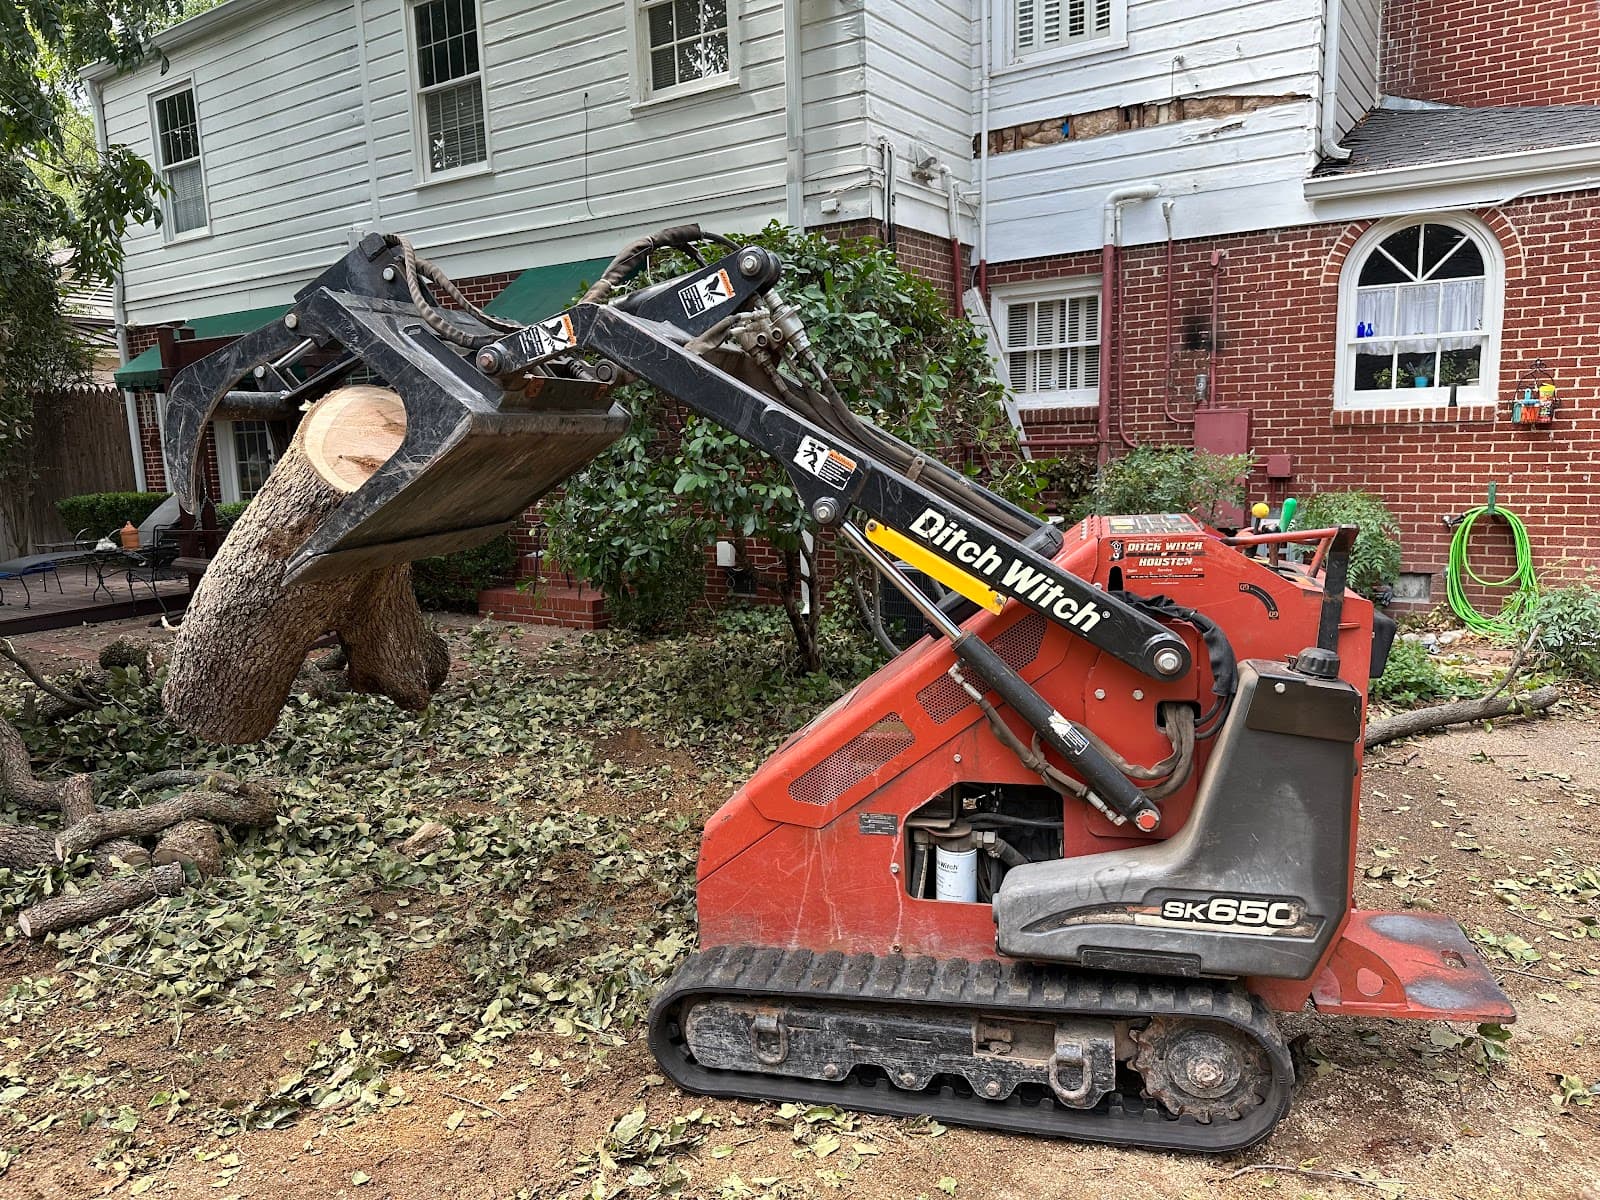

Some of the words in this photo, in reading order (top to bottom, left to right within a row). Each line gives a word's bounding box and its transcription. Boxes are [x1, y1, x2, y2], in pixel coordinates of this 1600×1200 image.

[1127, 542, 1162, 552] DITCH
[1165, 541, 1204, 551] WITCH
[909, 508, 1002, 575] Ditch
[1001, 558, 1102, 632] Witch
[1138, 557, 1193, 567] HOUSTON
[1163, 898, 1301, 926] SK650
